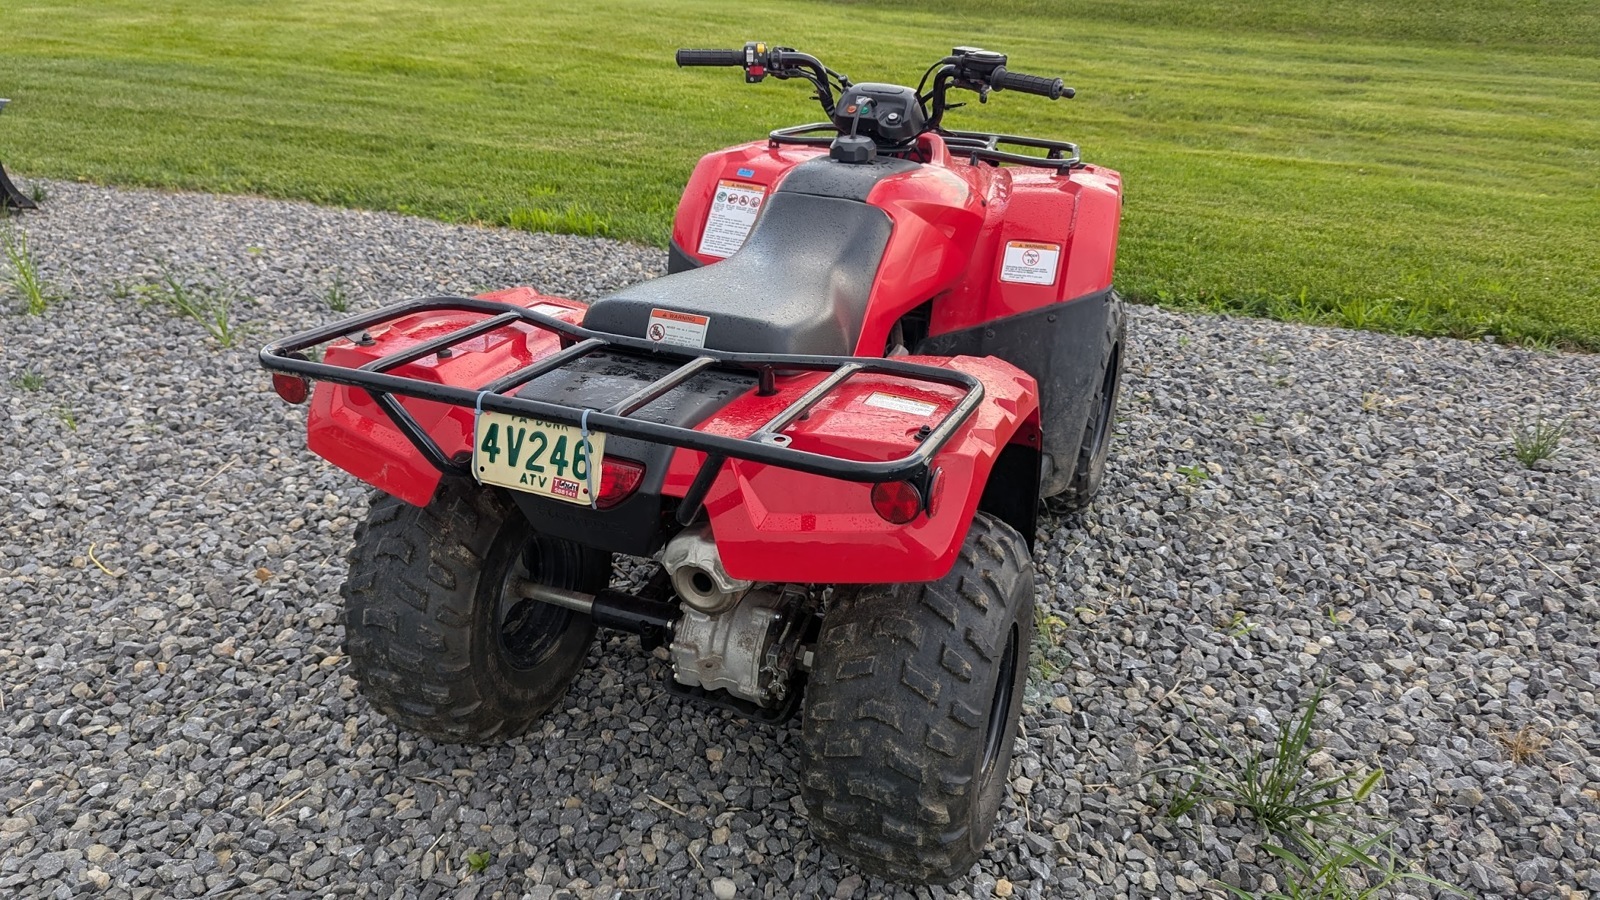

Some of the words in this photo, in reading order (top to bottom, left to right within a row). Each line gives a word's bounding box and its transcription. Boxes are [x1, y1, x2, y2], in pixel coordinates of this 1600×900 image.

[669, 313, 696, 322] WARNING
[481, 423, 593, 480] 4V246
[519, 472, 548, 488] ATV
